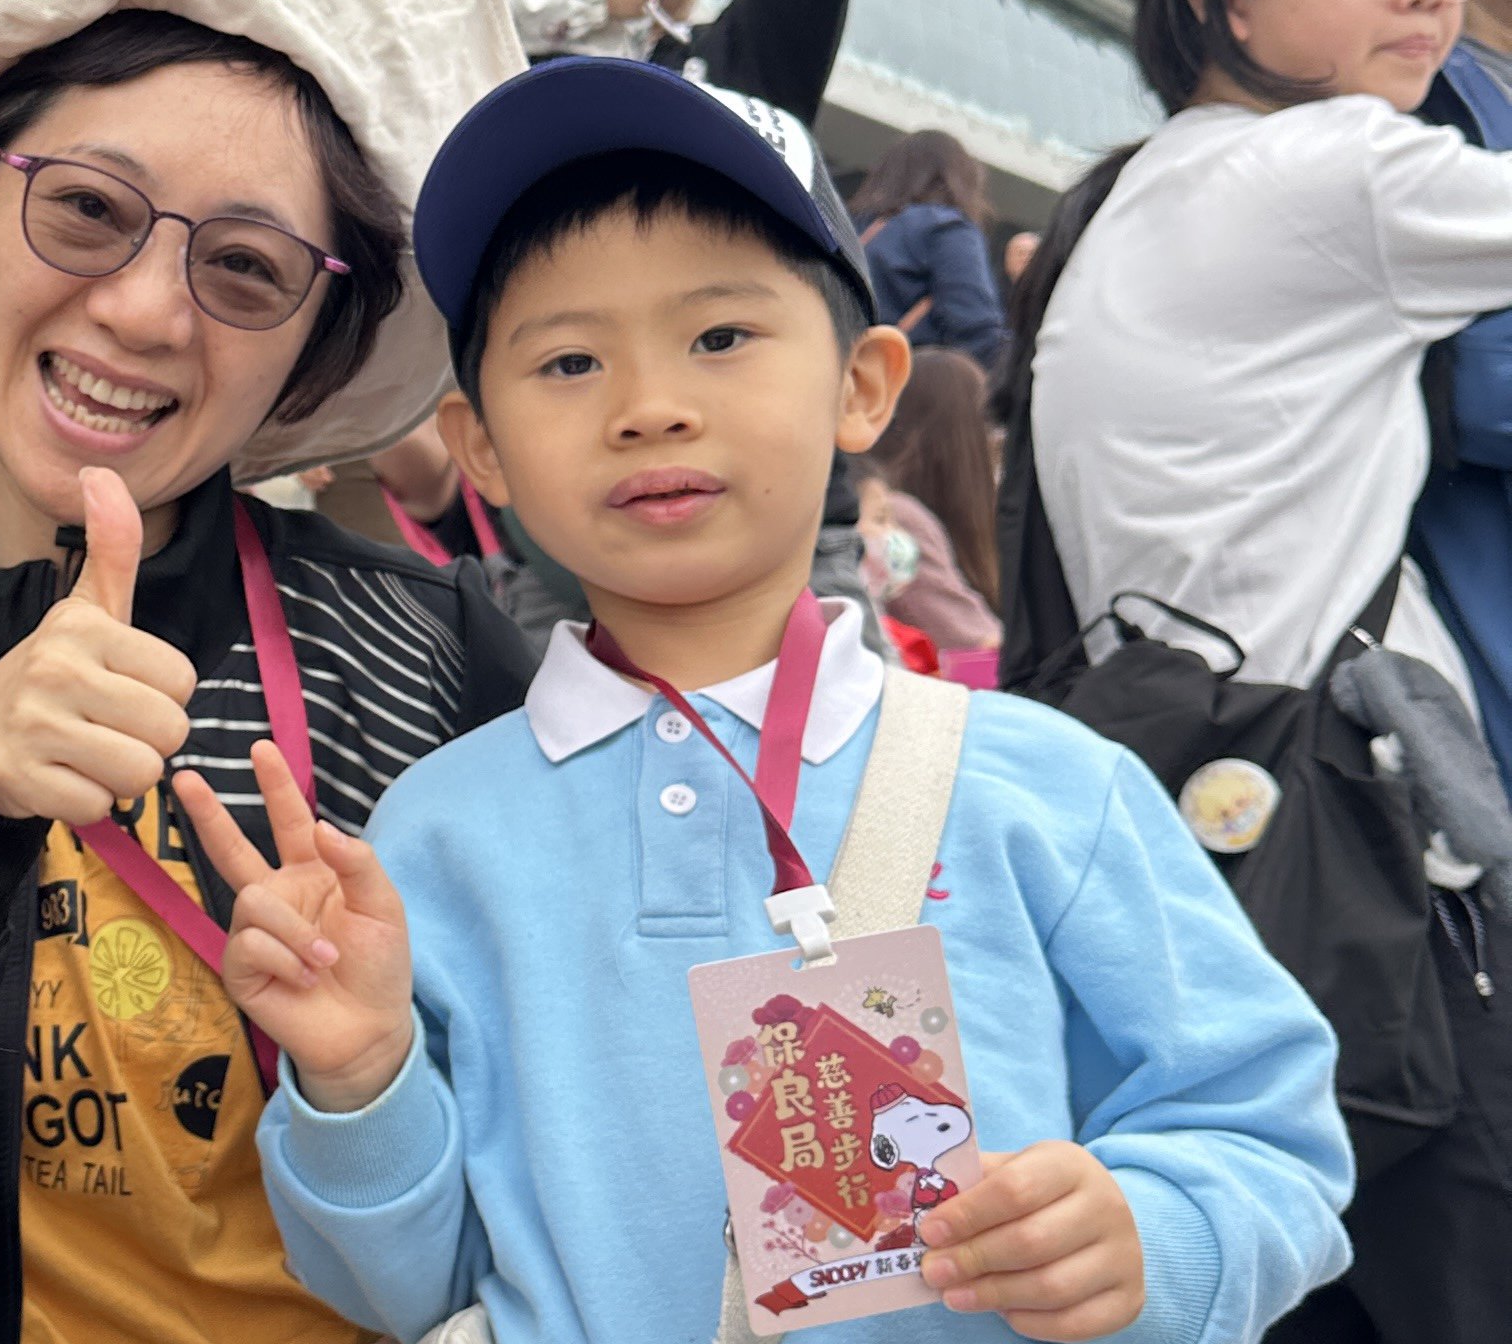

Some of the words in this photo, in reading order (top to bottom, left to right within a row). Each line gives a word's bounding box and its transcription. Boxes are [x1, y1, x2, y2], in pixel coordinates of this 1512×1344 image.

[756, 1022, 825, 1171] 保良局
[815, 1051, 871, 1210] 慈善步行
[82, 1162, 132, 1196] TAIL
[809, 1260, 871, 1288] SNOOPY
